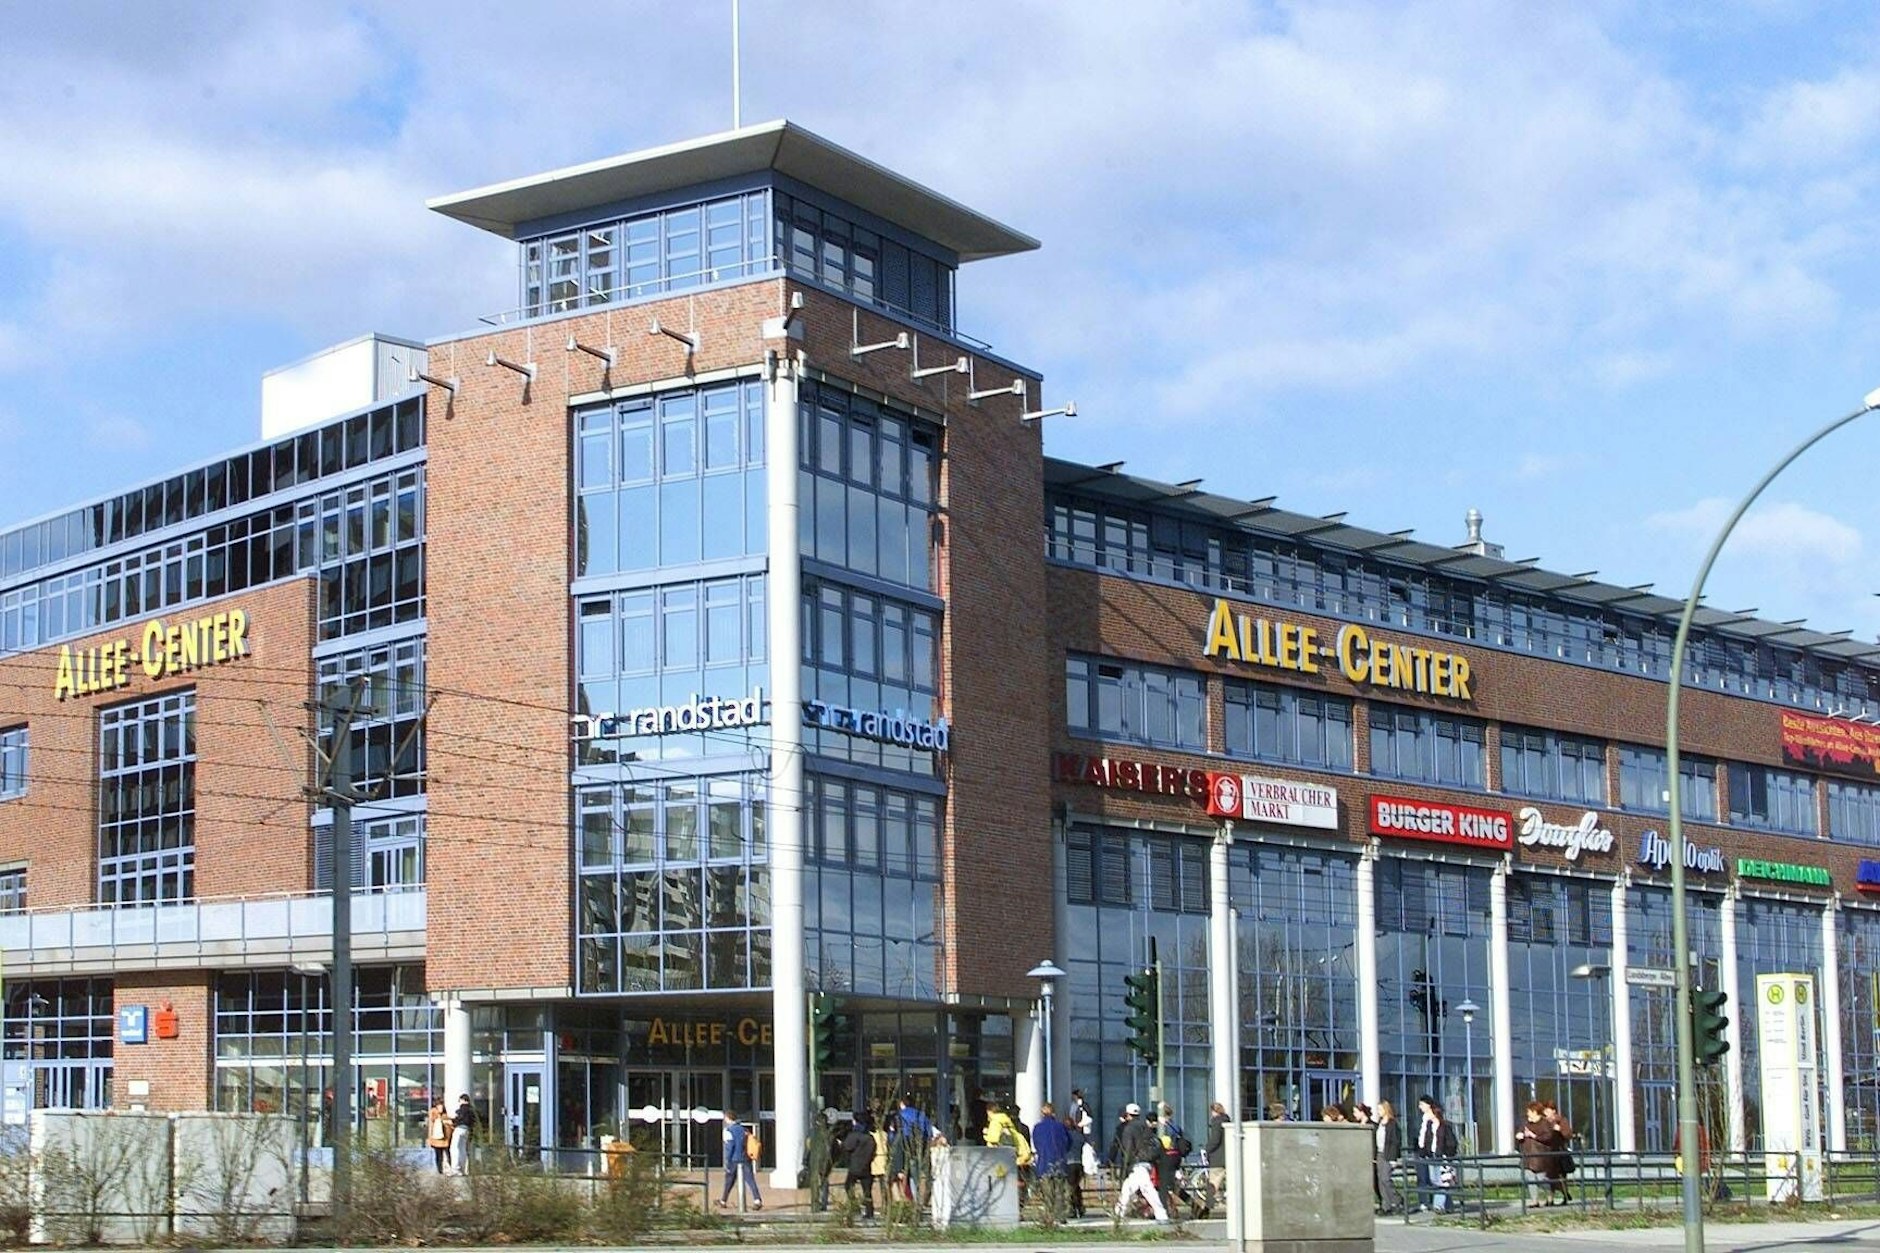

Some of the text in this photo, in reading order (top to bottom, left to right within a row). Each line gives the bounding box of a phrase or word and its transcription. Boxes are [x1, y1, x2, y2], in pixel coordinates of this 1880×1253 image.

[630, 687, 762, 734] randstad
[854, 707, 949, 751] randstad
[1054, 753, 1208, 799] KAISER'S
[1250, 781, 1331, 807] VERBRAUCHER
[1251, 800, 1289, 819] MARKT
[1377, 801, 1507, 842] BURGER KING
[1518, 807, 1615, 860] Douglas
[1641, 830, 1724, 873] Aplo optik
[1738, 858, 1830, 885] DEICHMANN
[649, 1017, 773, 1047] ALLEE-CE
